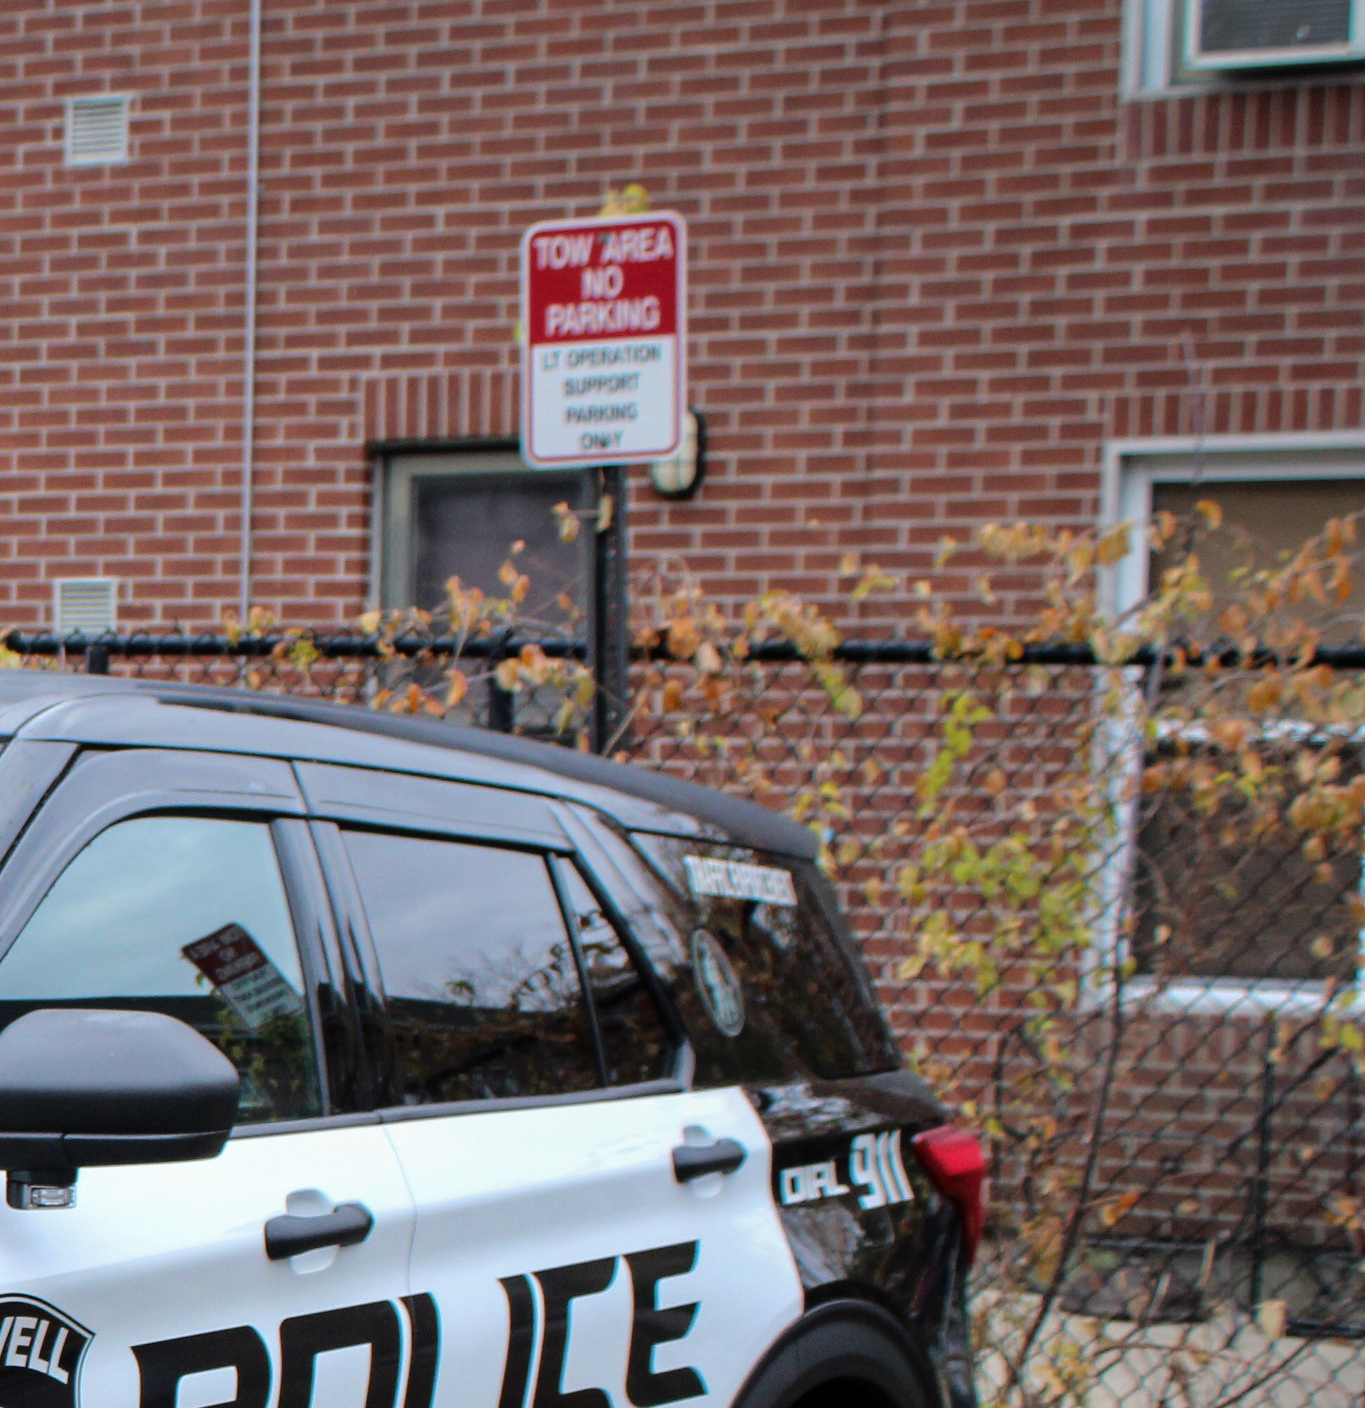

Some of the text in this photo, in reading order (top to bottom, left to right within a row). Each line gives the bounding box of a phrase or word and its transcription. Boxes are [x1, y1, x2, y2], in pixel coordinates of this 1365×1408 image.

[532, 226, 674, 270] TOW AREA
[580, 265, 624, 300] NO
[544, 297, 661, 337] PARKING
[566, 343, 662, 369] OPERATION
[564, 371, 640, 397] SUPPORT
[566, 402, 638, 424] PARKING
[848, 1128, 915, 1210] 911
